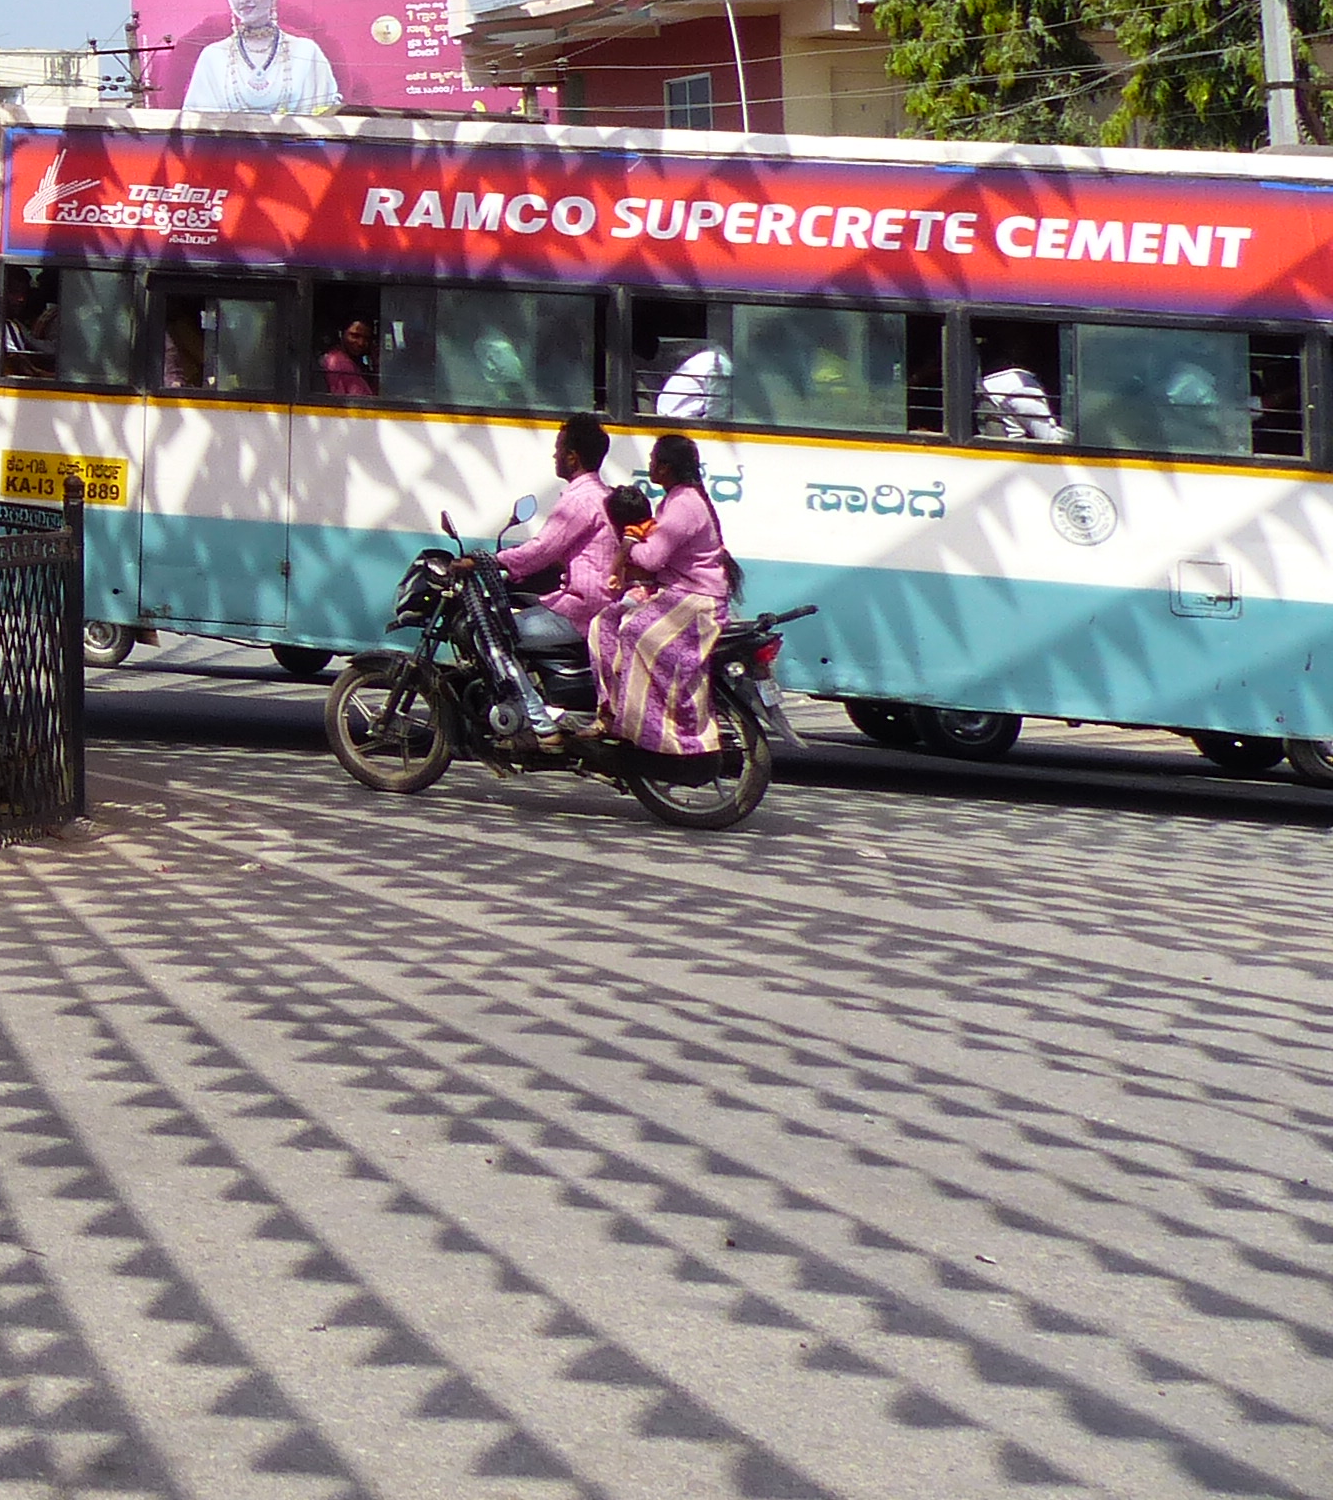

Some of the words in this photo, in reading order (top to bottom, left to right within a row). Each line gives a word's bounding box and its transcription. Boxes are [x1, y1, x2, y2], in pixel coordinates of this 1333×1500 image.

[359, 187, 597, 237] RAMCO
[610, 197, 978, 254] SUPERCRETE
[995, 215, 1252, 268] CEMENT
[5, 475, 55, 496] KA-13
[805, 481, 946, 519] ಸಾರಿಗೆ
